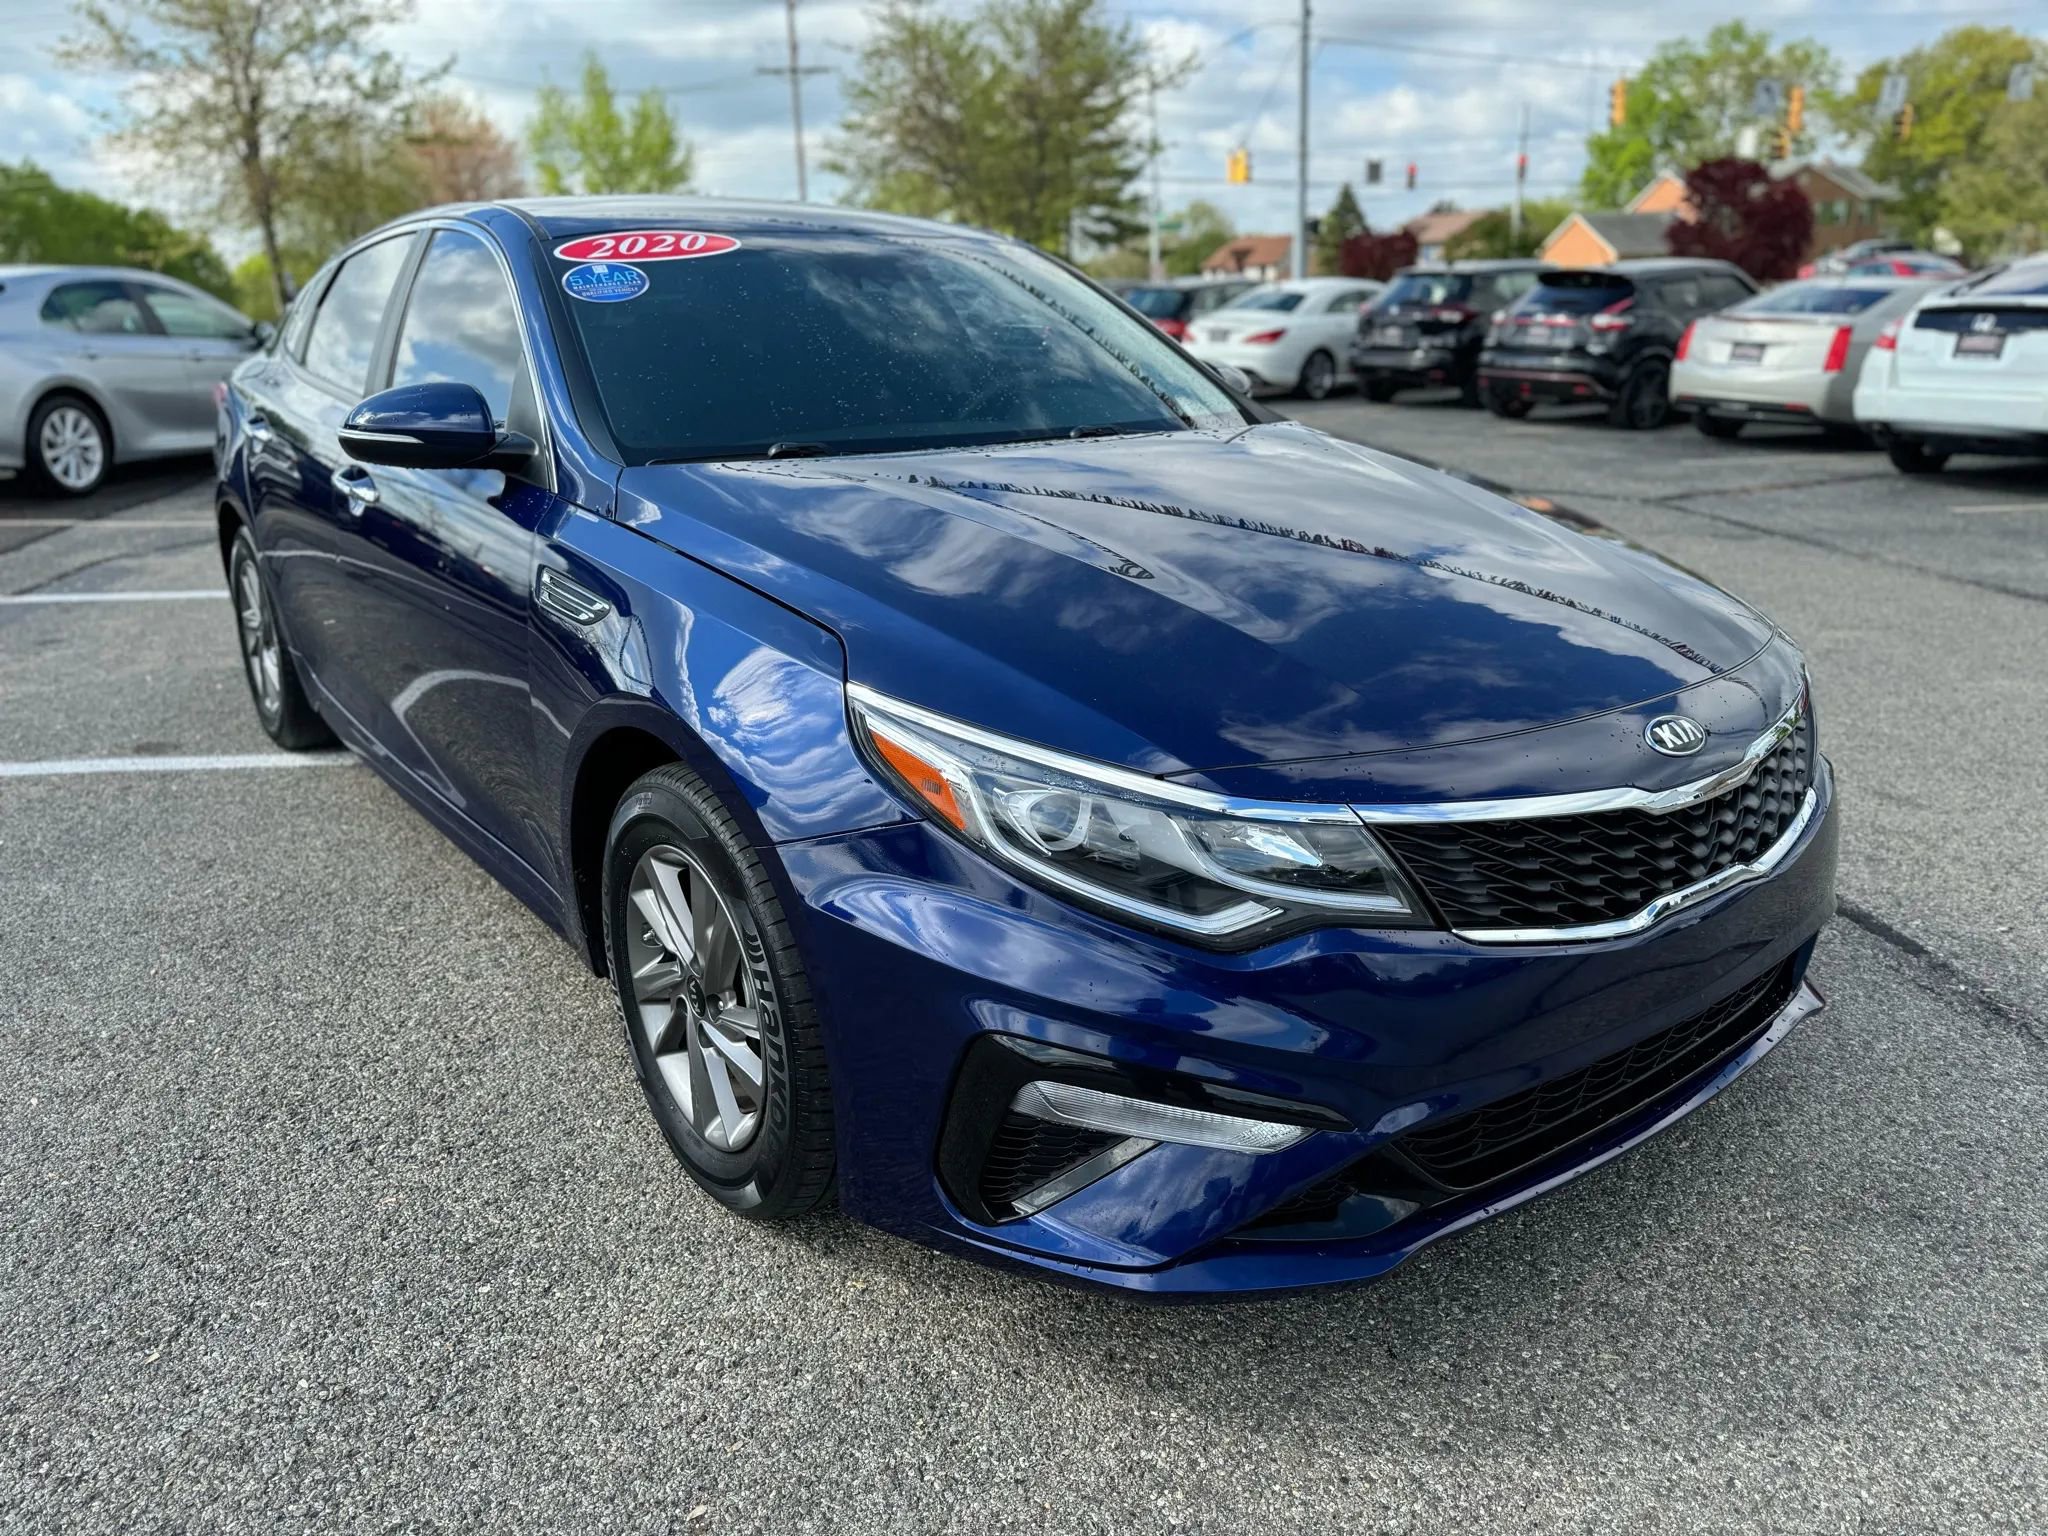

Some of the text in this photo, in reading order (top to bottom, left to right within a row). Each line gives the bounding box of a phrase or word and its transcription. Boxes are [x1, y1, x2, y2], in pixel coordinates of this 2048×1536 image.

[586, 234, 707, 259] 2020
[569, 271, 639, 286] 5 YEAR
[1652, 719, 1702, 748] KIA
